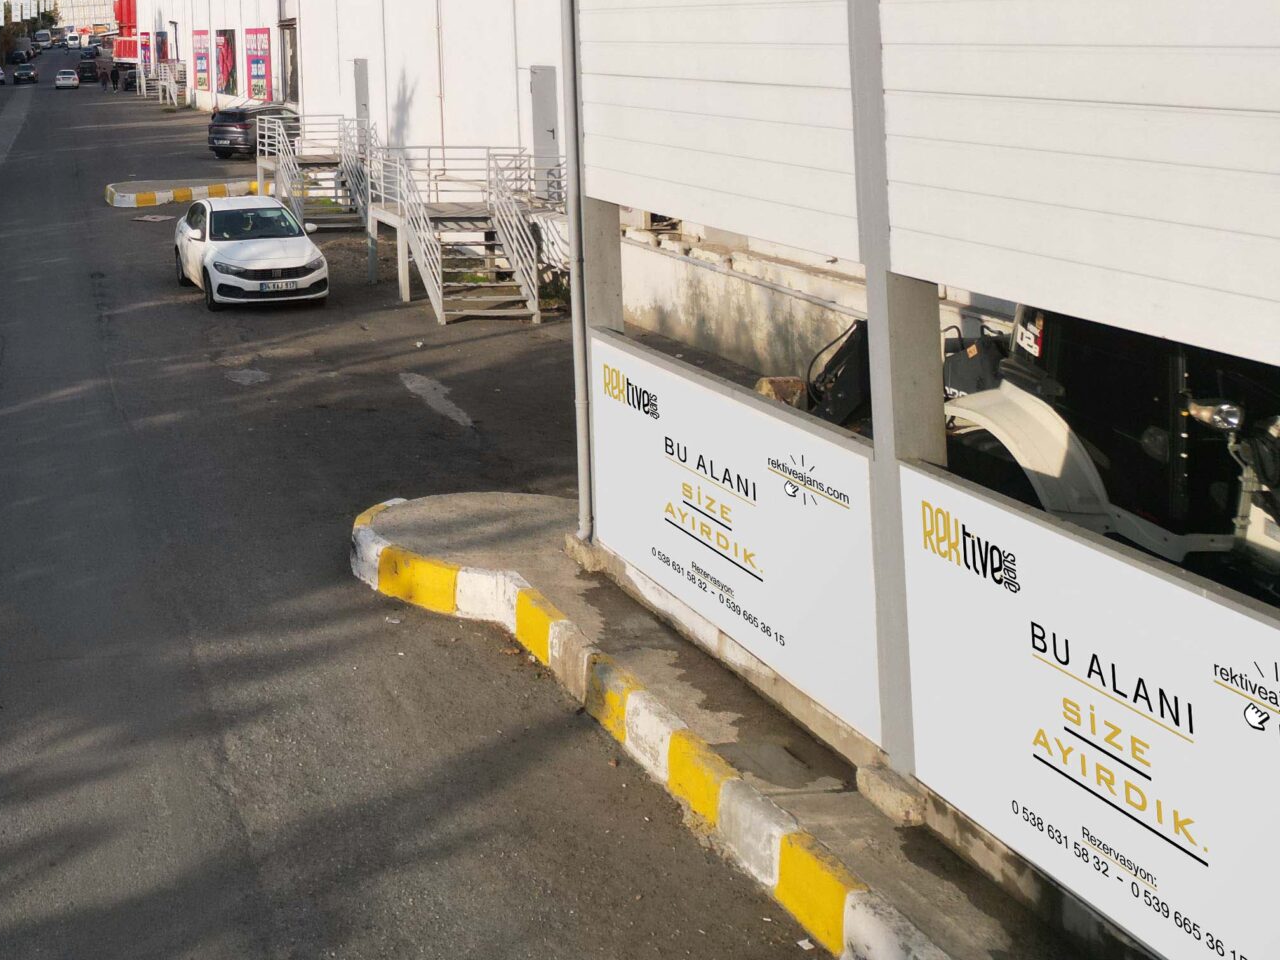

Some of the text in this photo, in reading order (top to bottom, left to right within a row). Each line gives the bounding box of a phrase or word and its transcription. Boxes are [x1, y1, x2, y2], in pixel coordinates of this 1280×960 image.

[664, 436, 757, 501] BU ALANI
[767, 457, 850, 504] rektiveajans.com
[682, 482, 732, 524] SİZE
[664, 502, 764, 573] AYIRDIK.
[651, 547, 657, 557] 0
[658, 551, 671, 567] 538
[672, 561, 685, 576] 631
[687, 571, 696, 584] 58
[698, 578, 708, 592] 32
[719, 594, 724, 604] 0
[726, 598, 741, 616] 539
[743, 610, 759, 628] 665
[761, 622, 772, 637] 36
[774, 632, 785, 647] 15
[691, 561, 735, 597] Rezervasyon:
[1002, 550, 1021, 593] ajans
[1030, 620, 1194, 735] BU ALANI
[1213, 663, 1280, 707] rektivea
[1062, 697, 1151, 768] SİZE
[1032, 728, 1208, 853] AYIRDIK.
[1011, 800, 1019, 815] 0
[1022, 806, 1044, 832] 538
[1047, 824, 1068, 849] 631
[1073, 842, 1090, 863] 58
[1093, 855, 1110, 878] 32
[1131, 881, 1140, 898] 0
[1143, 889, 1170, 919] 539
[1174, 911, 1202, 941] 665
[1205, 932, 1225, 957] 36
[1081, 826, 1158, 888] Rezervasyon:
